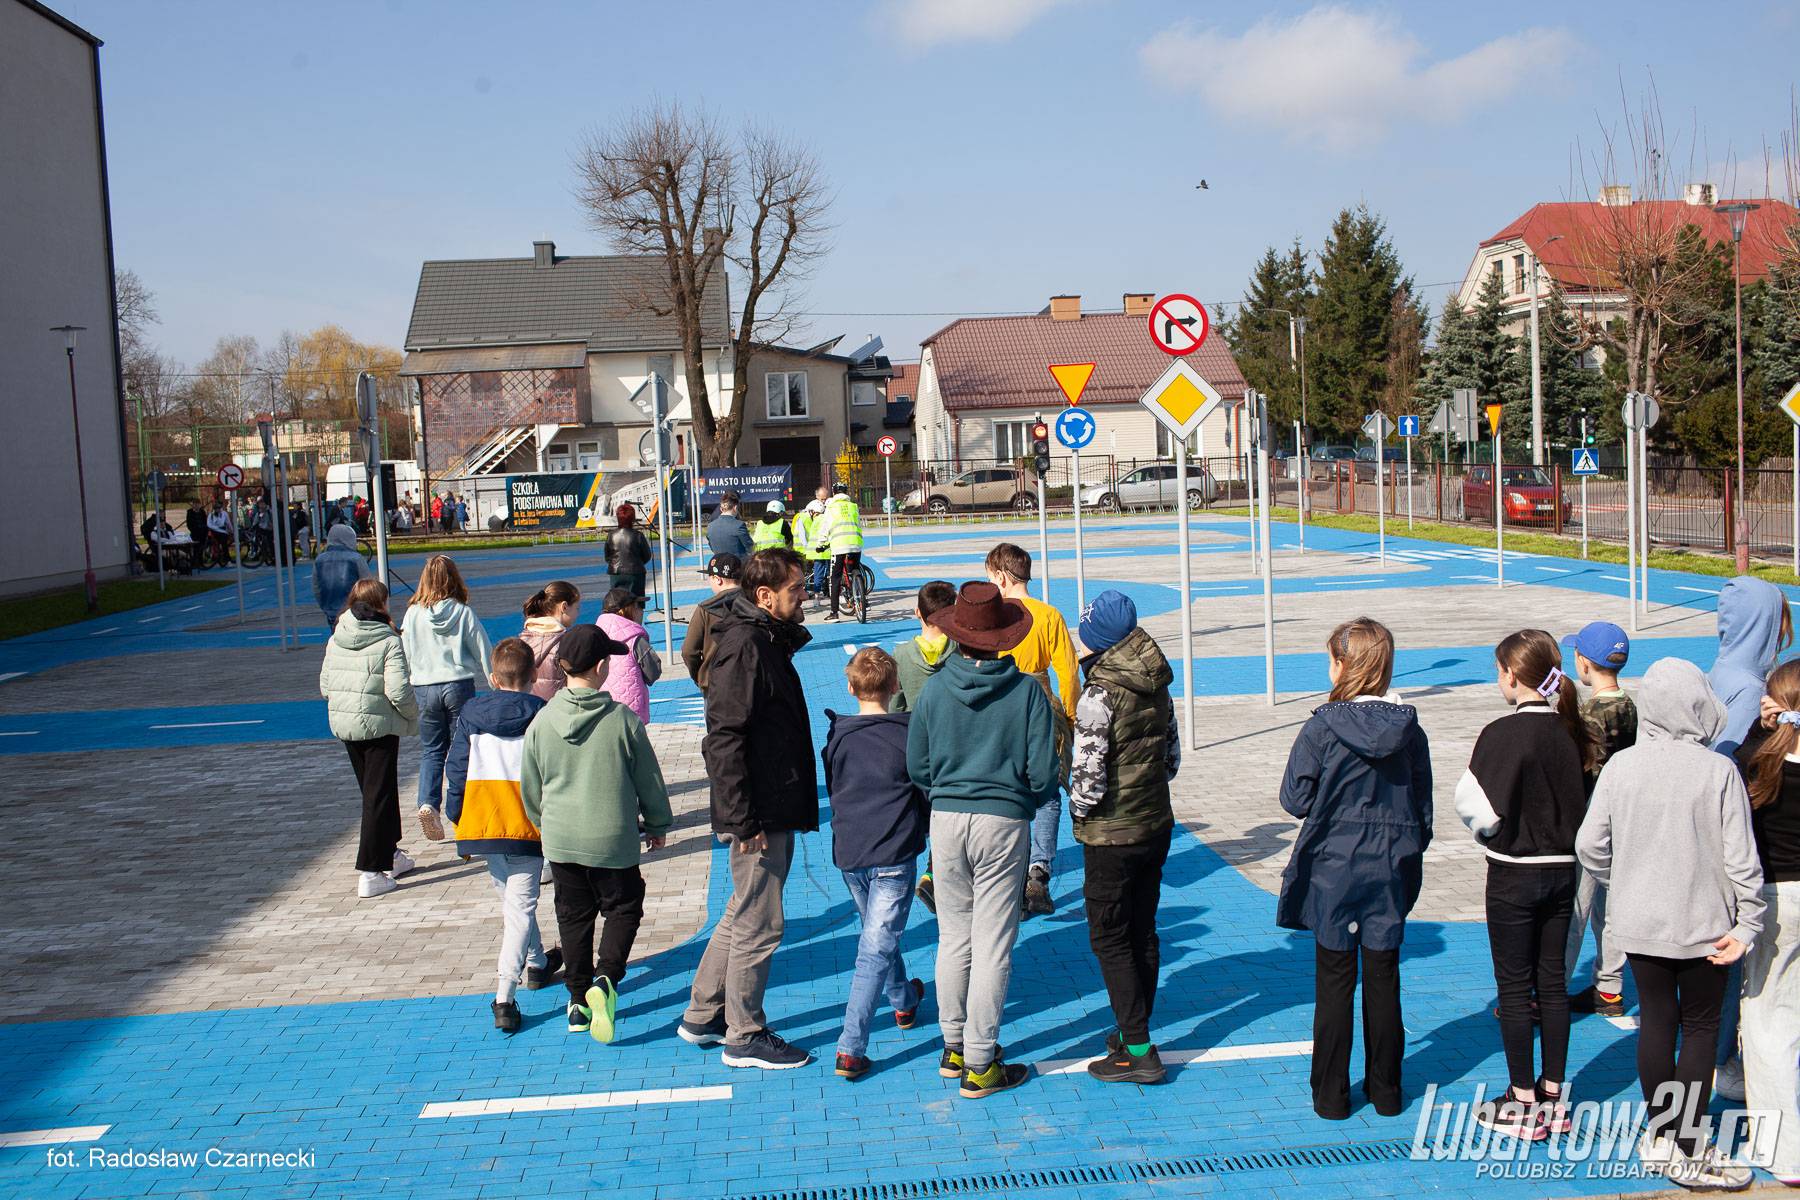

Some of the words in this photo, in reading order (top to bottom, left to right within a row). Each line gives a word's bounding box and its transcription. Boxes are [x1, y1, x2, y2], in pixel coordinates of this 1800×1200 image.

[708, 477, 739, 486] MIASTO
[741, 475, 785, 485] LUBARTÓW
[512, 482, 540, 495] SZKOŁA
[513, 495, 563, 510] PODSTAWOWA
[564, 494, 574, 508] NR
[575, 494, 578, 507] 1
